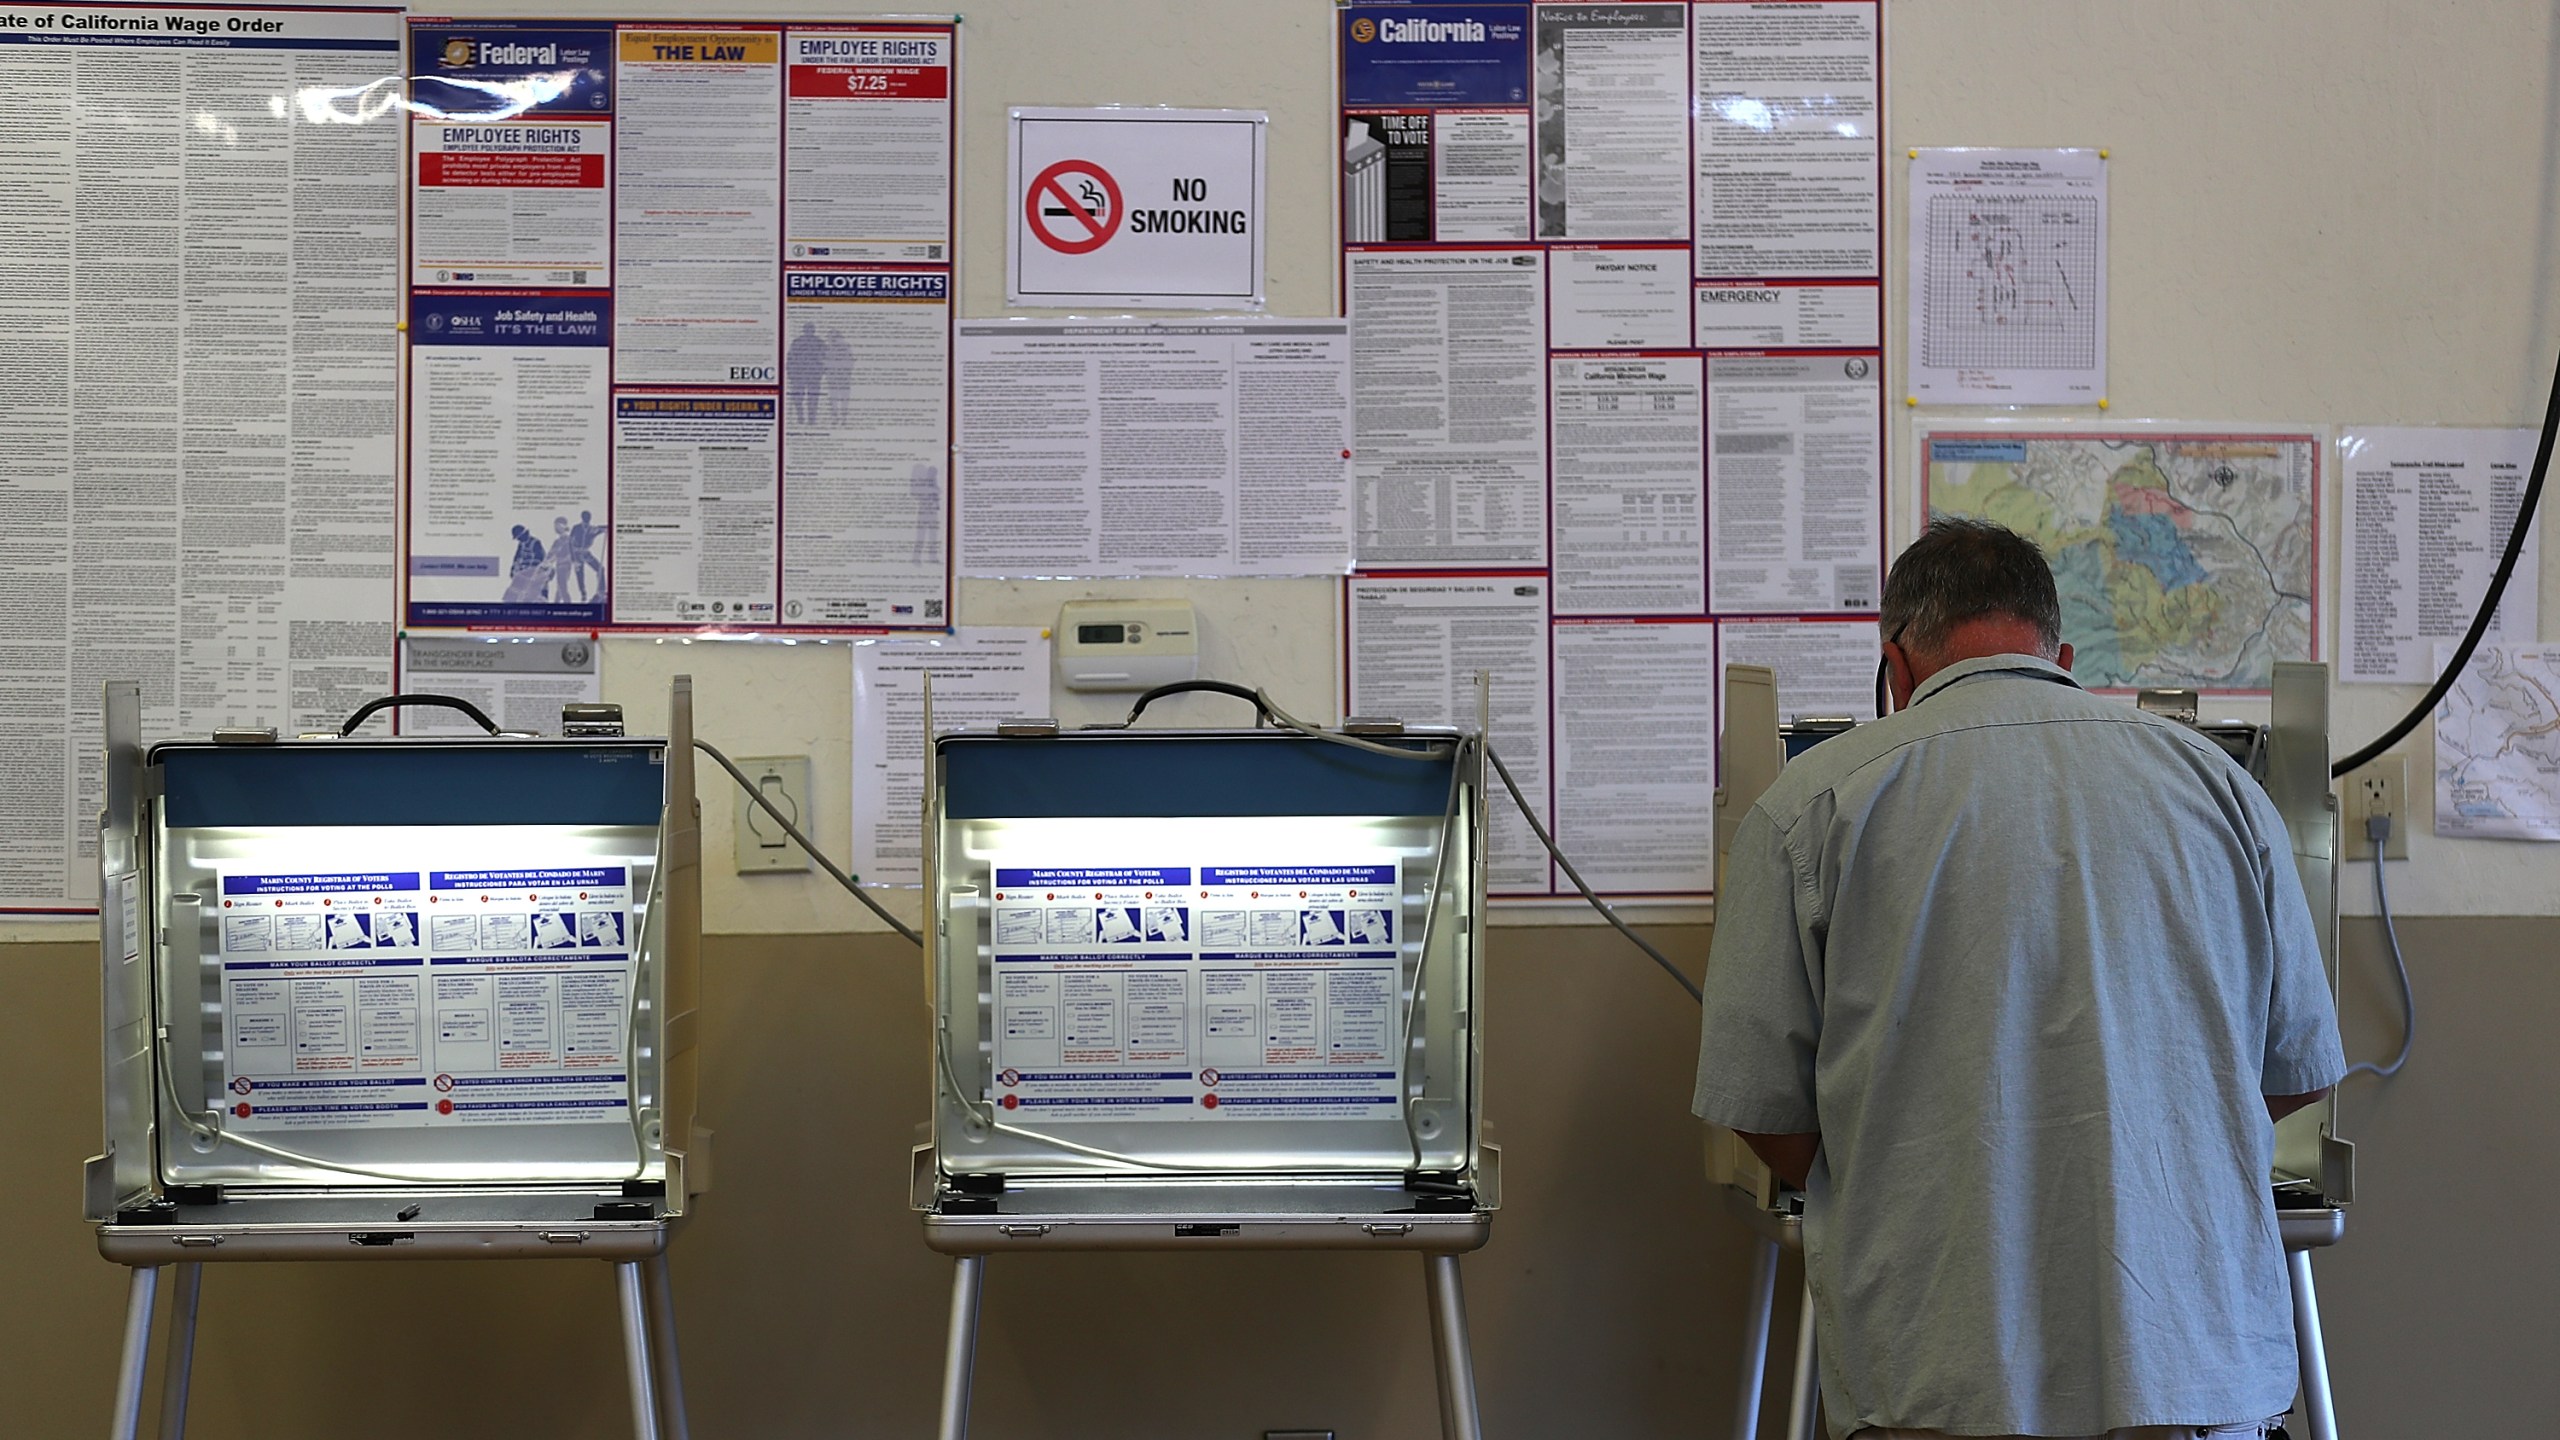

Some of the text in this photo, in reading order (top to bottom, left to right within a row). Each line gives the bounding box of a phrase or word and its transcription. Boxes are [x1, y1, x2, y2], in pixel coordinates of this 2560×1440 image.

[34, 14, 55, 28] of
[61, 14, 159, 31] California
[165, 16, 220, 34] Wage
[227, 17, 283, 32] Order
[1380, 18, 1484, 43] California
[27, 36, 41, 44] This
[42, 36, 61, 44] Order
[62, 36, 79, 44] Must
[90, 37, 113, 45] Posted
[114, 37, 134, 45] Where
[135, 37, 171, 46] Employees
[172, 38, 185, 46] Can
[186, 38, 204, 46] Read
[210, 38, 230, 46] Easily
[625, 33, 772, 46] Equal Employment Opportunity is
[480, 43, 556, 65] Federal
[652, 45, 745, 61] THE LAW
[800, 40, 936, 56] EMPLOYEE RIGHTS
[562, 56, 588, 64] Postings
[848, 75, 886, 91] $7.25
[1382, 116, 1428, 130] TIME OFF
[443, 128, 581, 144] EMPLOYEE RIGHTS
[1389, 131, 1429, 144] TO VOTE
[480, 144, 521, 152] POLYGRAPH
[1173, 178, 1206, 201] NO
[1131, 210, 1246, 234] SMOKING
[1595, 264, 1656, 272] PAYDAY NOTICE
[790, 275, 943, 289] EMPLOYEE RIGHTS
[1701, 290, 1778, 302] EMERGENCY
[495, 310, 596, 323] Job Safety and Health
[495, 324, 596, 336] IT'S THE LAW!
[730, 367, 773, 380] EEOC
[479, 872, 487, 880] DE
[582, 870, 605, 878] MARIN
[1123, 869, 1132, 877] OF
[1249, 868, 1257, 876] DE
[284, 876, 311, 884] COUNTY
